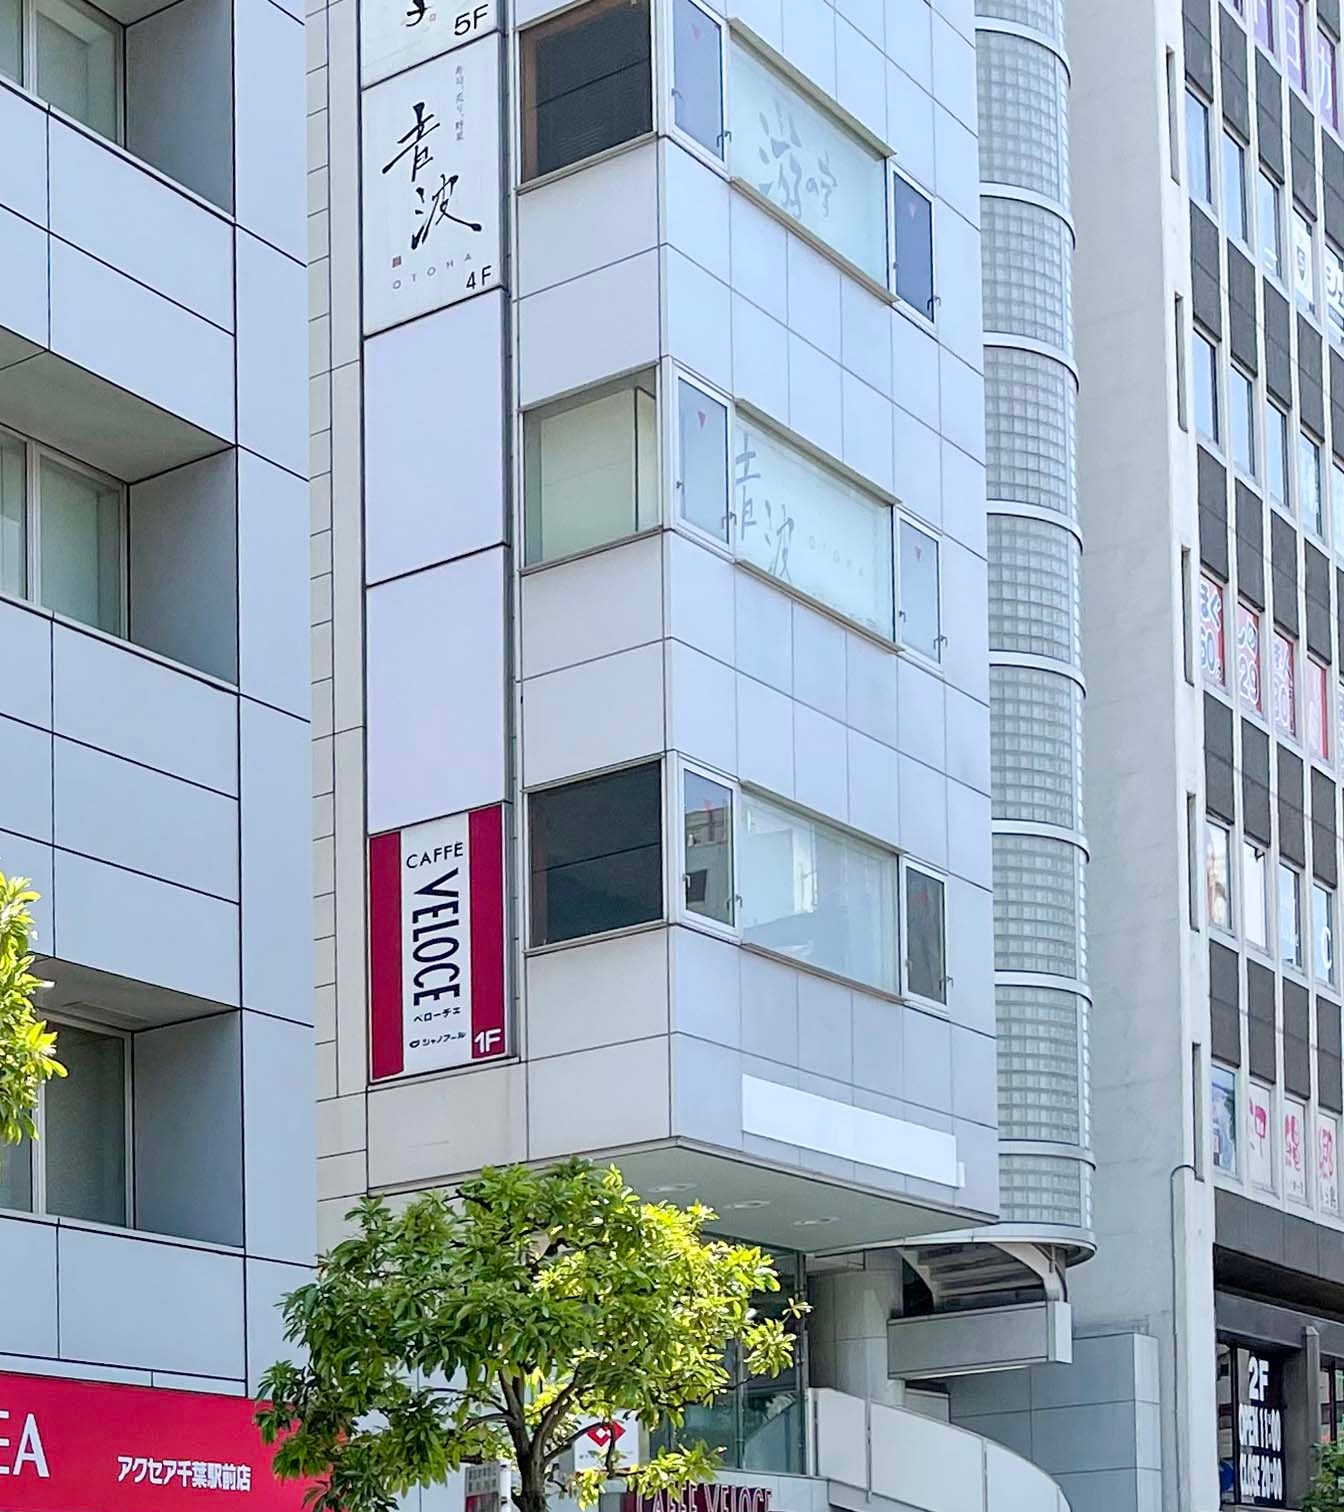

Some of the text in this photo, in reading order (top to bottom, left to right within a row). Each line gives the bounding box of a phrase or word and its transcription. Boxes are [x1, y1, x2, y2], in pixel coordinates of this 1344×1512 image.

[454, 4, 489, 36] 5F
[466, 265, 492, 289] 4F
[412, 867, 461, 1006] VELOCE
[473, 1028, 502, 1054] 1F
[1249, 1356, 1269, 1402] 2F
[117, 1456, 251, 1492] アクセア千葉駅前店
